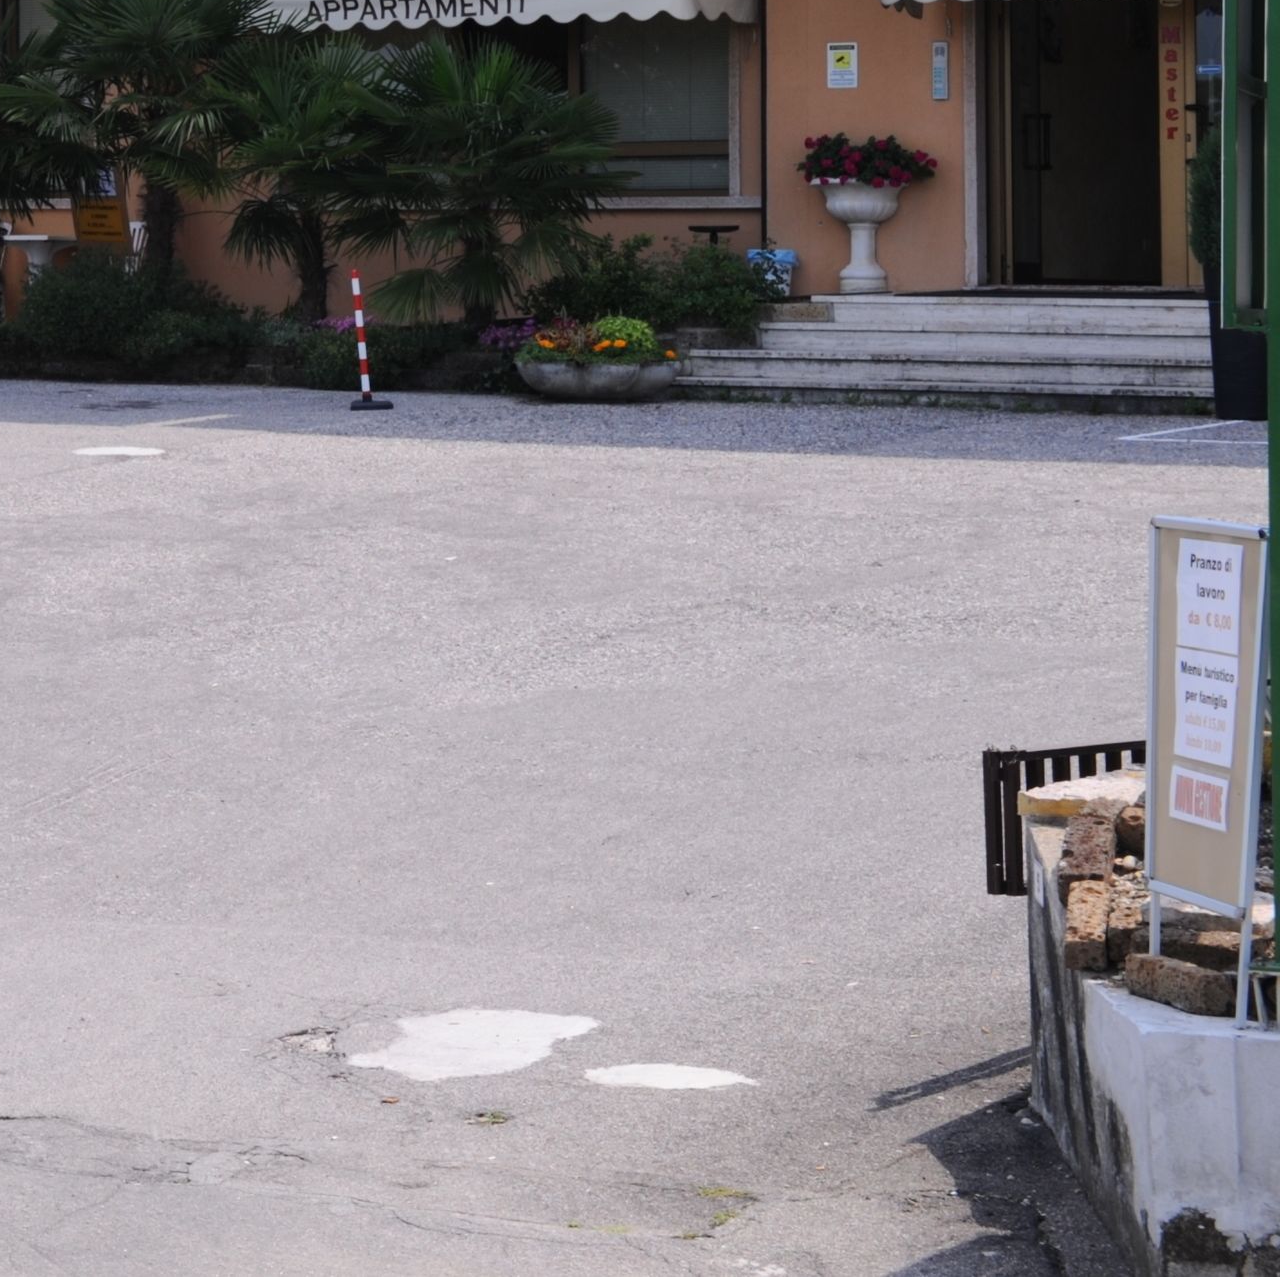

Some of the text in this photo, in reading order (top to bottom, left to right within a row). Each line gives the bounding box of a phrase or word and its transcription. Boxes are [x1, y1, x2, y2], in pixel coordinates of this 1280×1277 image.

[1160, 25, 1182, 140] Master
[1190, 553, 1232, 572] Pranzo di
[1196, 583, 1226, 600] lavoro
[1185, 689, 1198, 704] per
